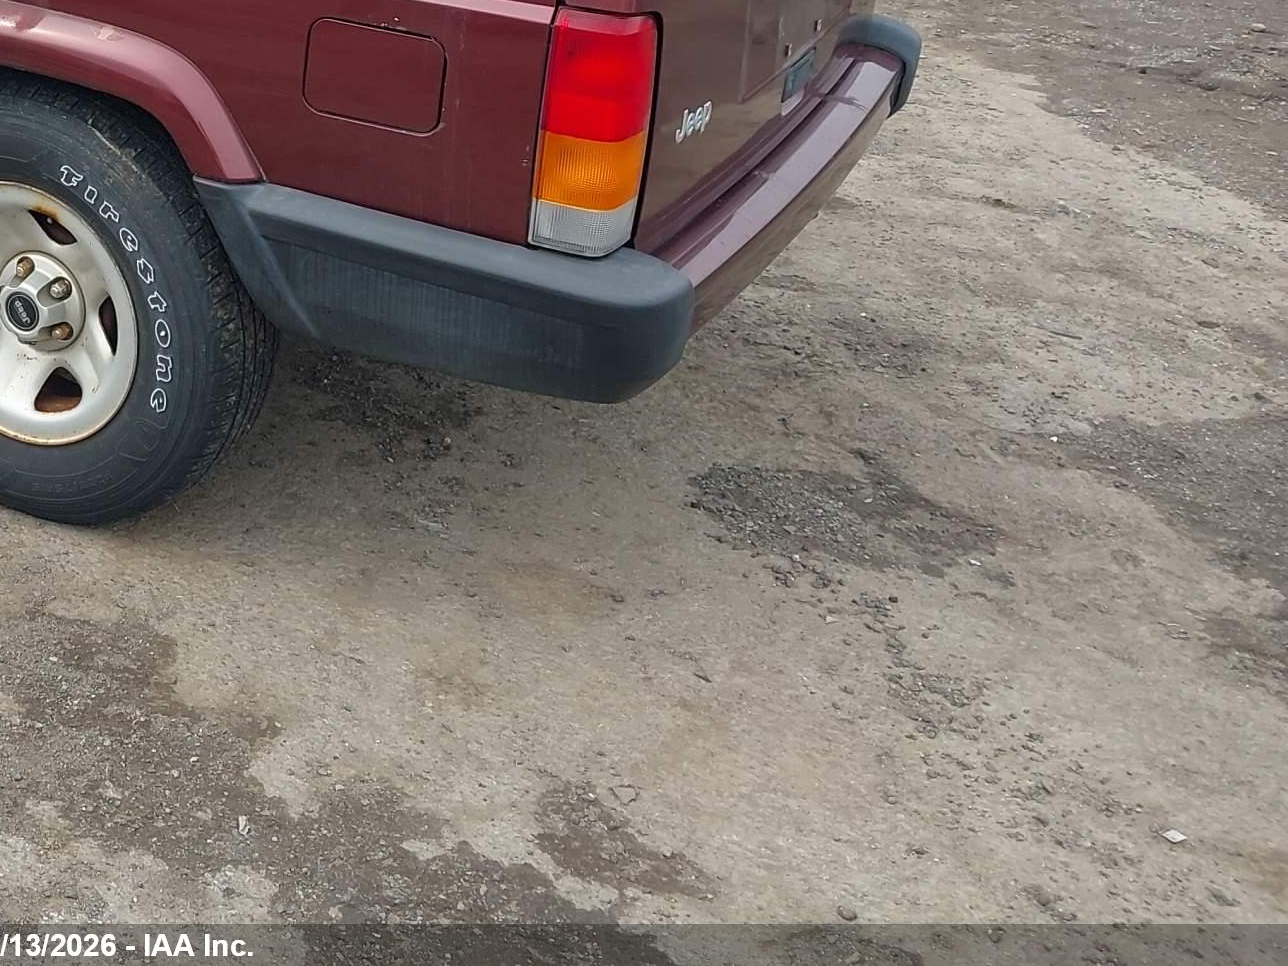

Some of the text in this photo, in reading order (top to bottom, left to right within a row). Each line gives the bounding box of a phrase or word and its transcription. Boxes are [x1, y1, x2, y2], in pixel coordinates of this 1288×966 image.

[675, 100, 713, 144] Jeep
[58, 163, 175, 414] Firestone
[14, 300, 31, 325] Jeep
